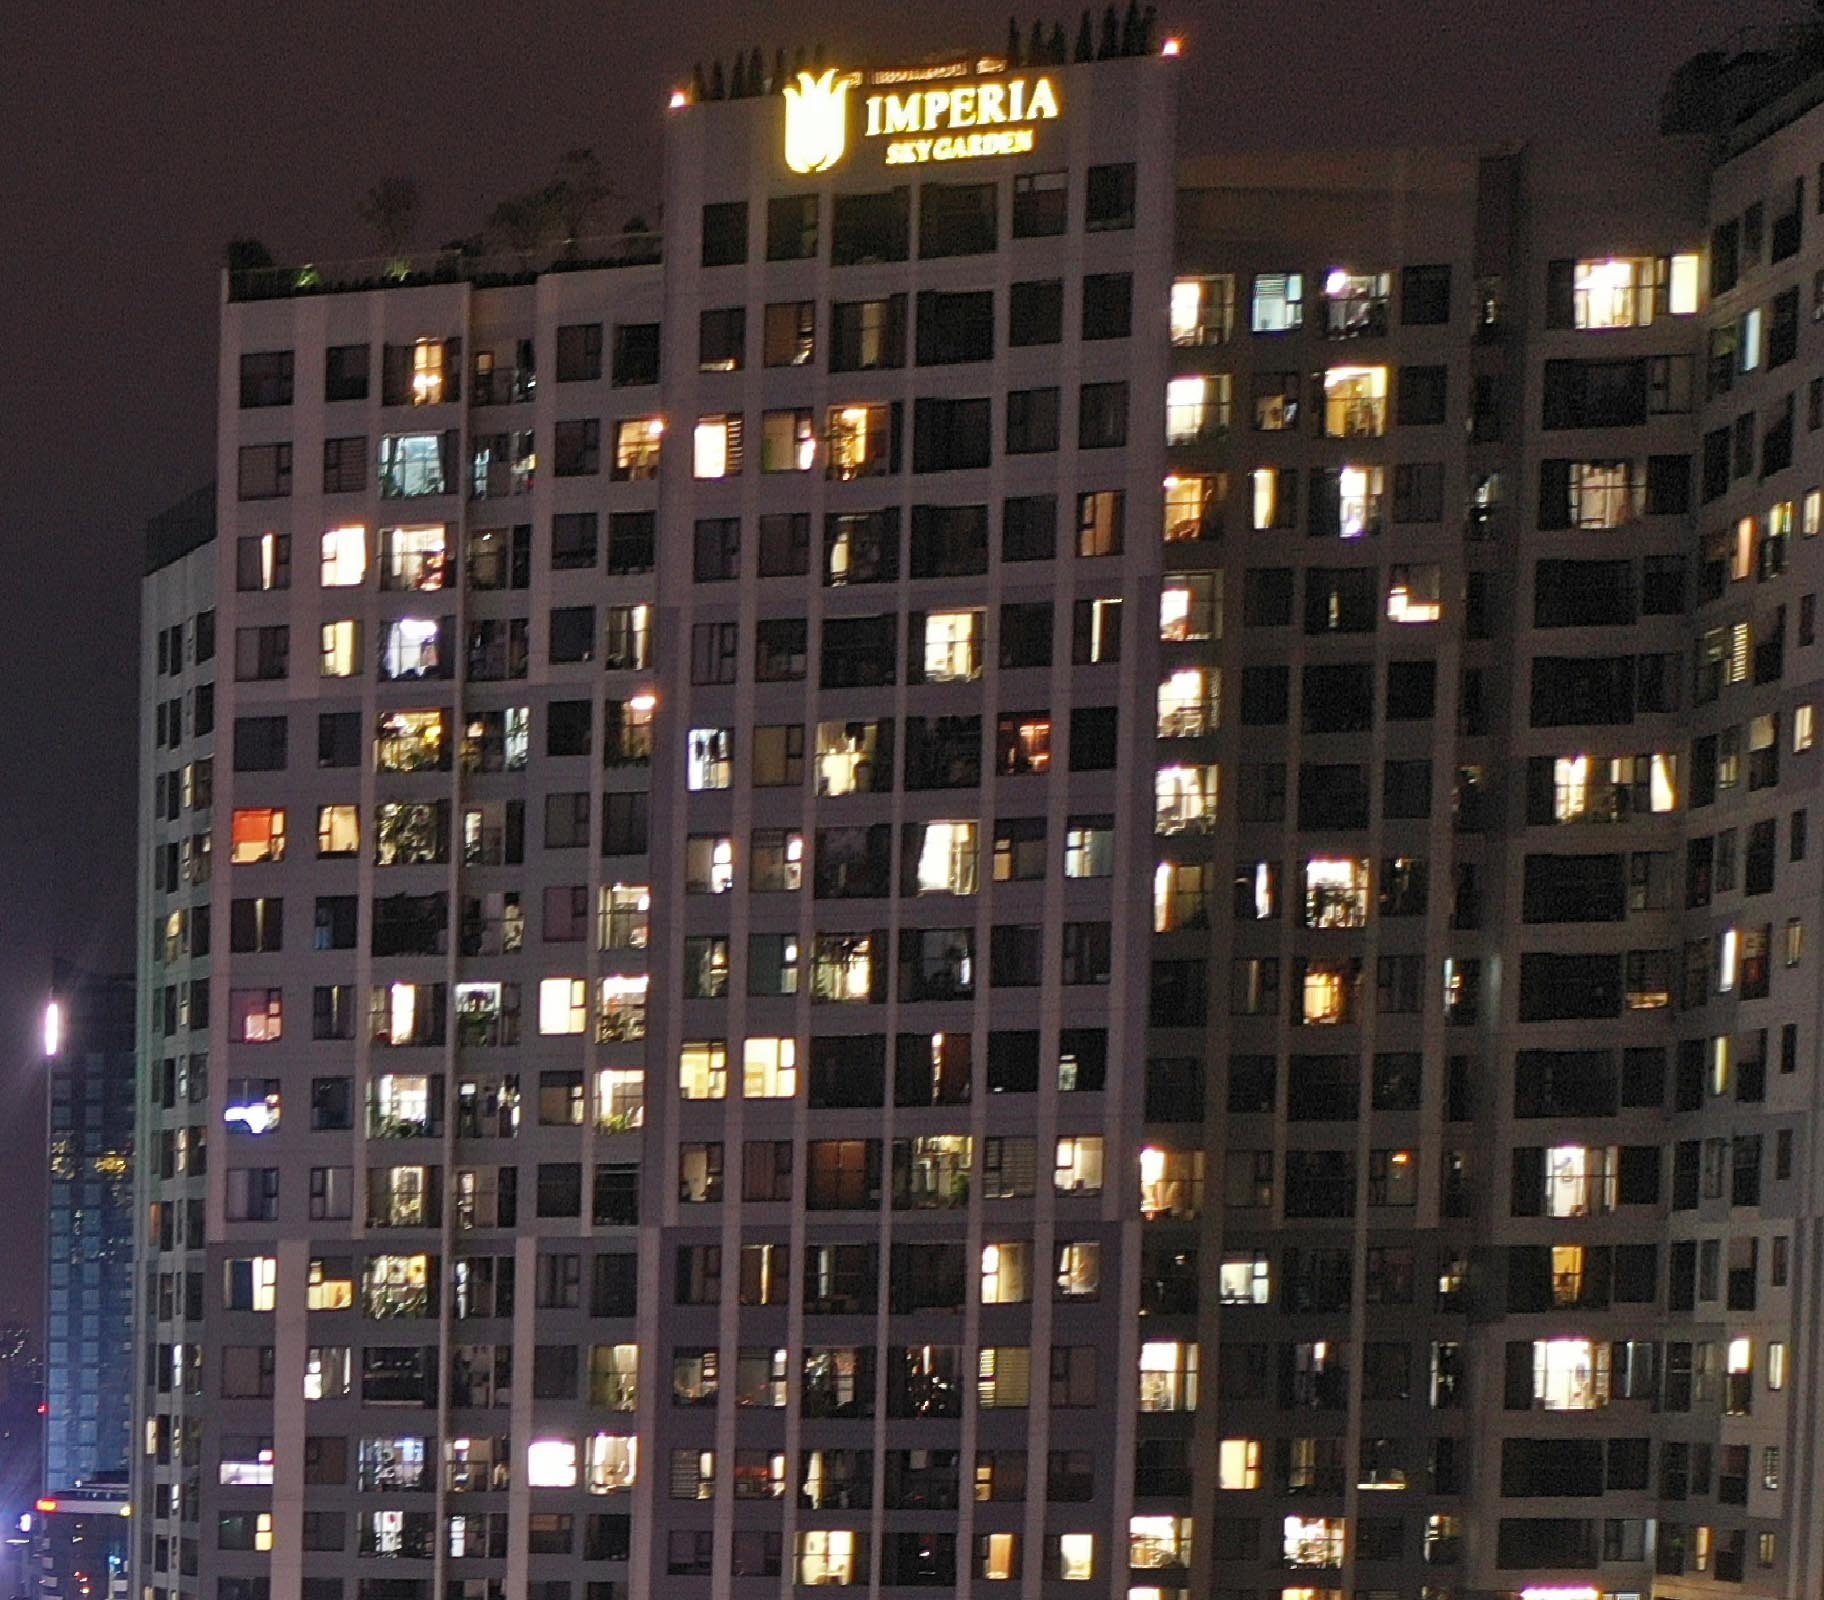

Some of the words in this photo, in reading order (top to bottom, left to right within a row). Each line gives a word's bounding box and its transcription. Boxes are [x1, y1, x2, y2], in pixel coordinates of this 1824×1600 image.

[865, 78, 1058, 136] IMPERIA
[885, 138, 934, 164] SKY
[933, 129, 1034, 160] GARDEN
